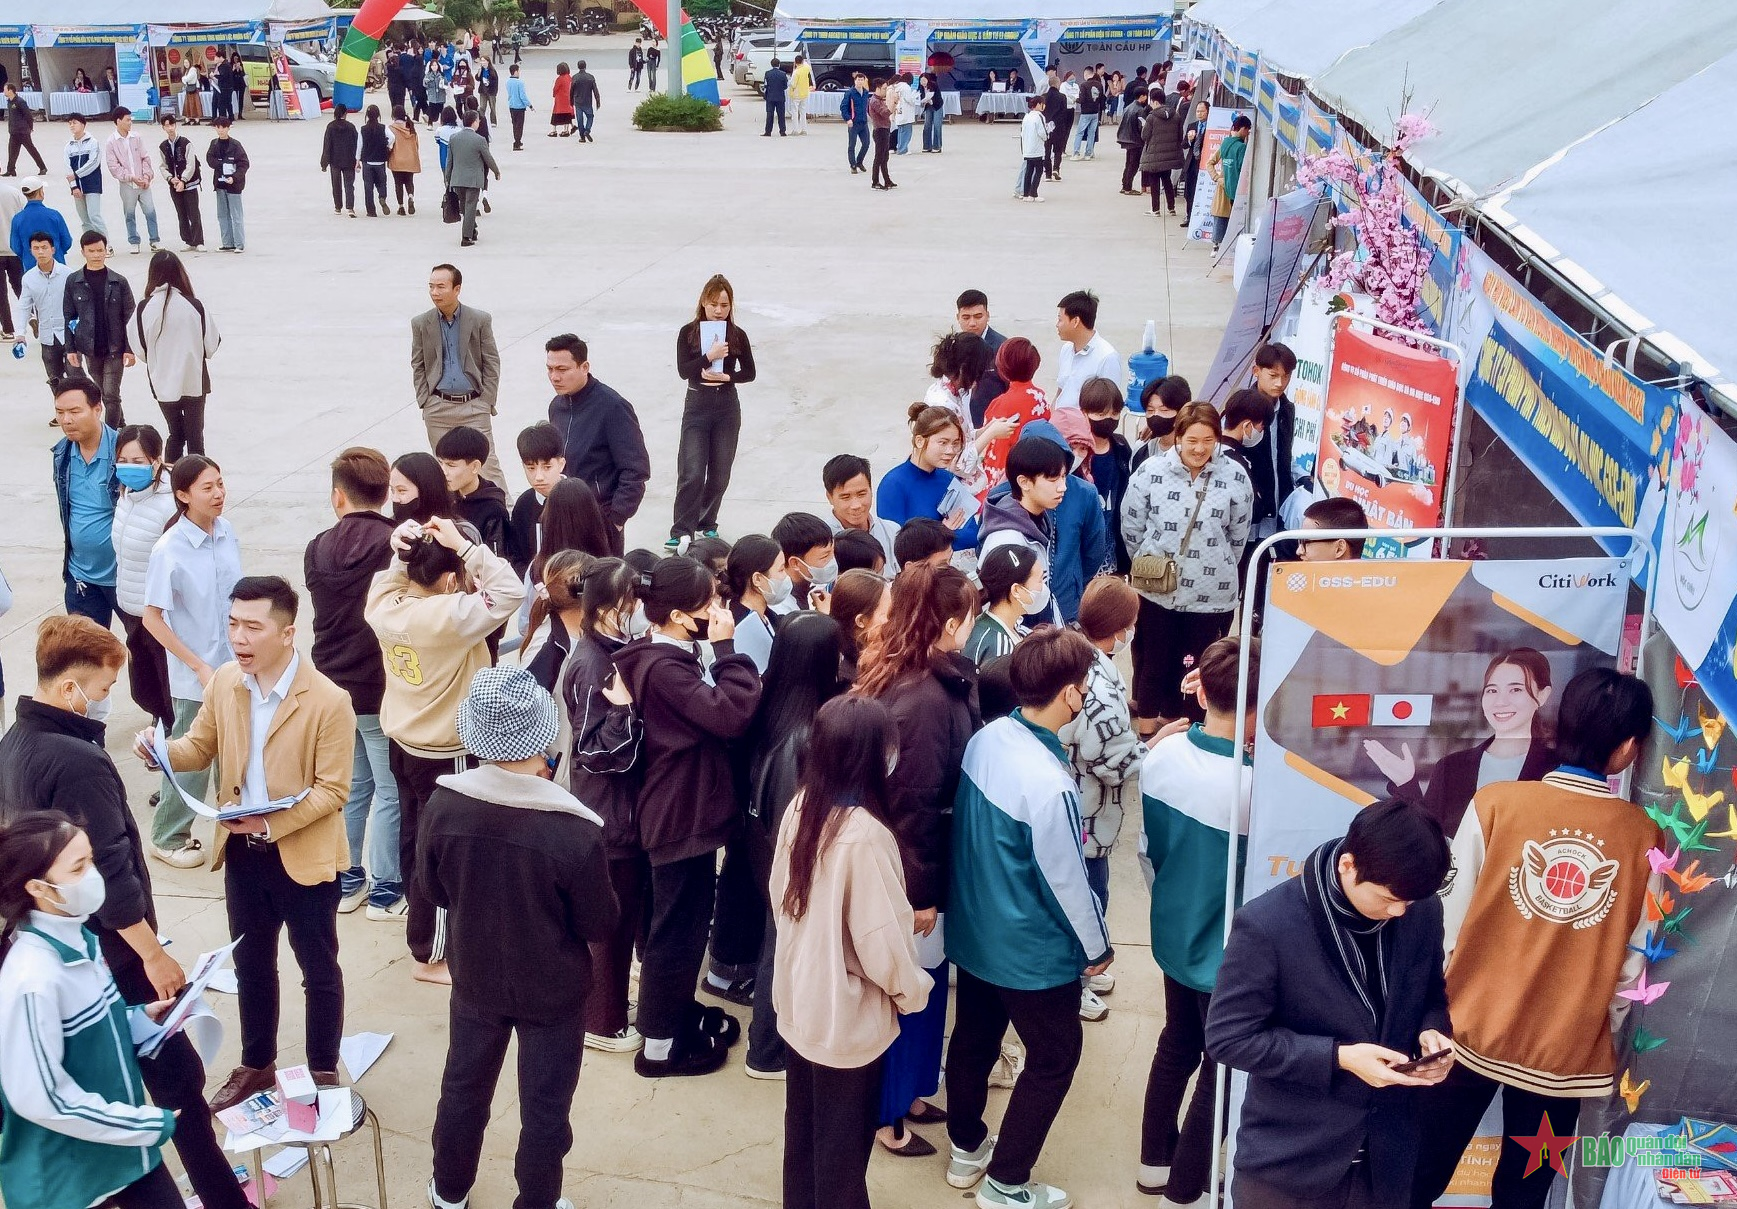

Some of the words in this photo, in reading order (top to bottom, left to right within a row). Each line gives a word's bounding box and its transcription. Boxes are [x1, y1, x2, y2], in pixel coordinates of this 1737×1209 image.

[1087, 41, 1113, 52] TOÀN
[1115, 40, 1136, 52] CẦU
[1138, 43, 1151, 51] HP
[1345, 480, 1355, 491] DU
[1354, 483, 1370, 498] HỌC
[1318, 576, 1398, 588] GSS-EDU
[1538, 573, 1617, 589] CitiWork
[1267, 855, 1306, 878] Tu
[1534, 894, 1583, 915] BASKETBALL
